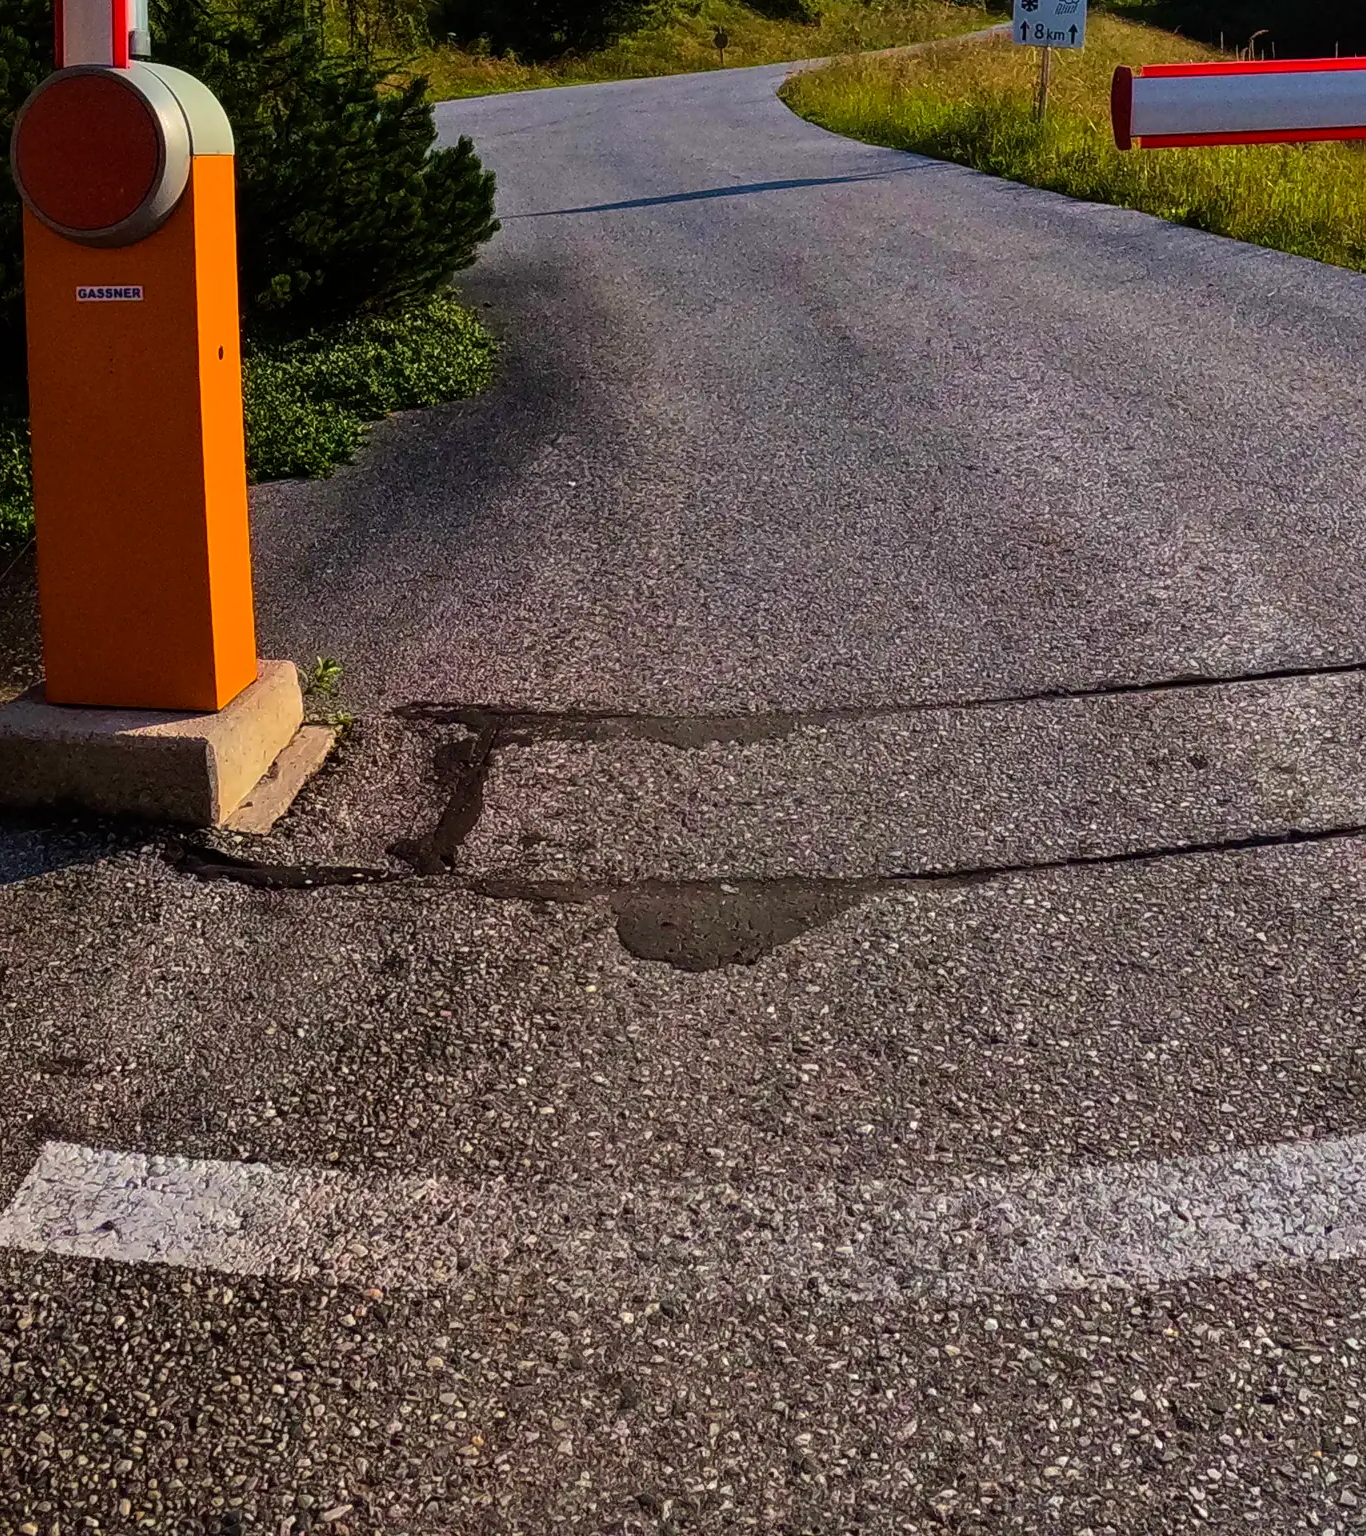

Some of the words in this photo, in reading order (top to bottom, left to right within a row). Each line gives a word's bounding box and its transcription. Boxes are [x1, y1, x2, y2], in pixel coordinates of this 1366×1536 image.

[1035, 23, 1045, 39] 8
[1046, 28, 1065, 40] km
[78, 287, 141, 299] GASSNER
